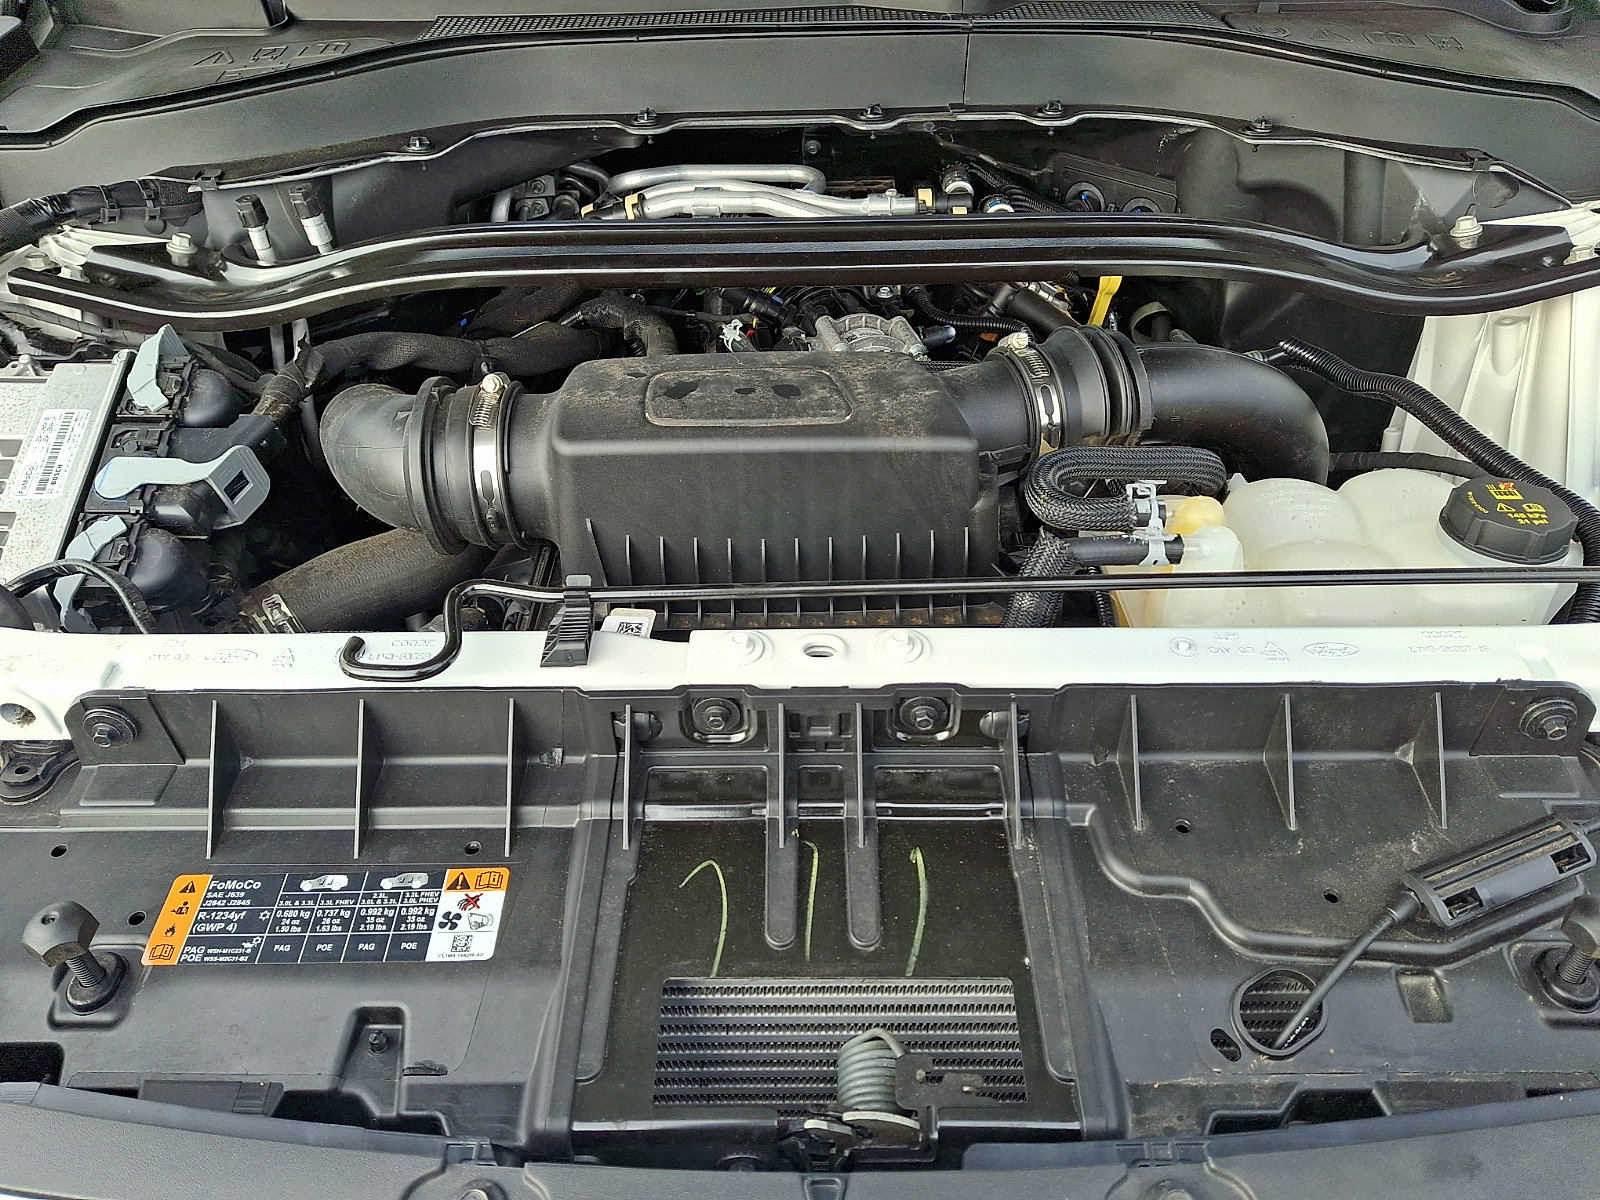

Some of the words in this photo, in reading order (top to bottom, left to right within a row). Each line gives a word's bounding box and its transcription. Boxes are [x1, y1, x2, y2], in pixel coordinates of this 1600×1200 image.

[51, 464, 63, 485] BOSCH
[209, 880, 262, 890] FoMoCo
[197, 911, 246, 921] R-1234yf
[276, 910, 299, 918] 0.680
[300, 910, 310, 919] kg
[338, 909, 351, 919] kg
[360, 908, 383, 916] 0.992
[384, 908, 395, 917] kg
[401, 908, 424, 916] 0.992
[425, 908, 436, 917] kg
[193, 924, 225, 933] (GWP
[226, 923, 238, 932] 4)
[183, 946, 206, 954] PAG
